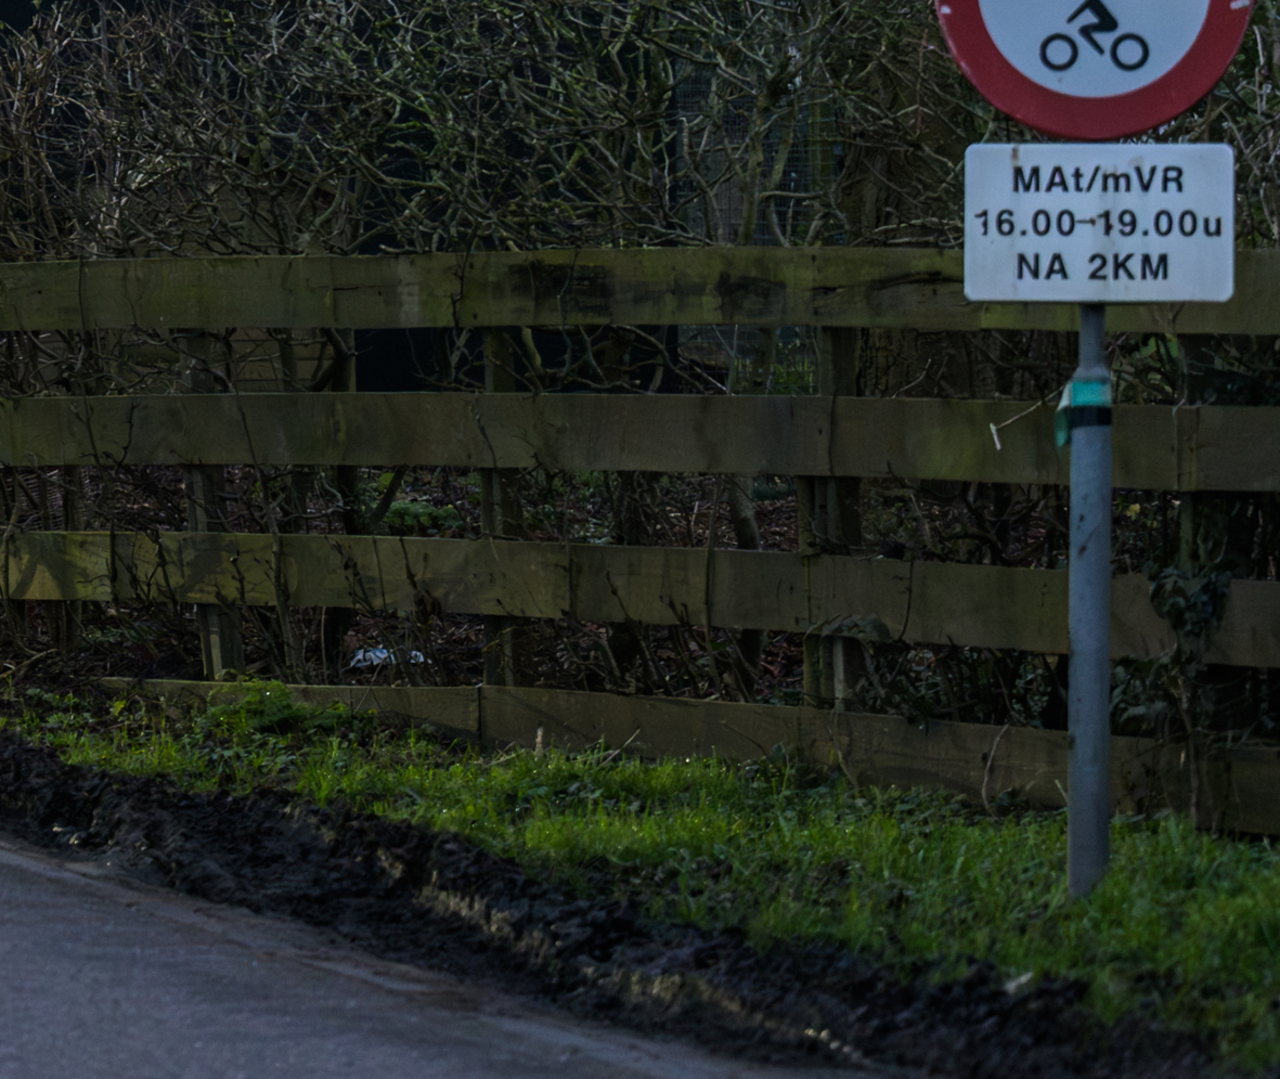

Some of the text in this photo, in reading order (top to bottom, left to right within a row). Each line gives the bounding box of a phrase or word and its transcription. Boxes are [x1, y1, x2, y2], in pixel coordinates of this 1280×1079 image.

[1012, 165, 1183, 193] MAt/mVR
[1017, 253, 1168, 280] NA 2KM
